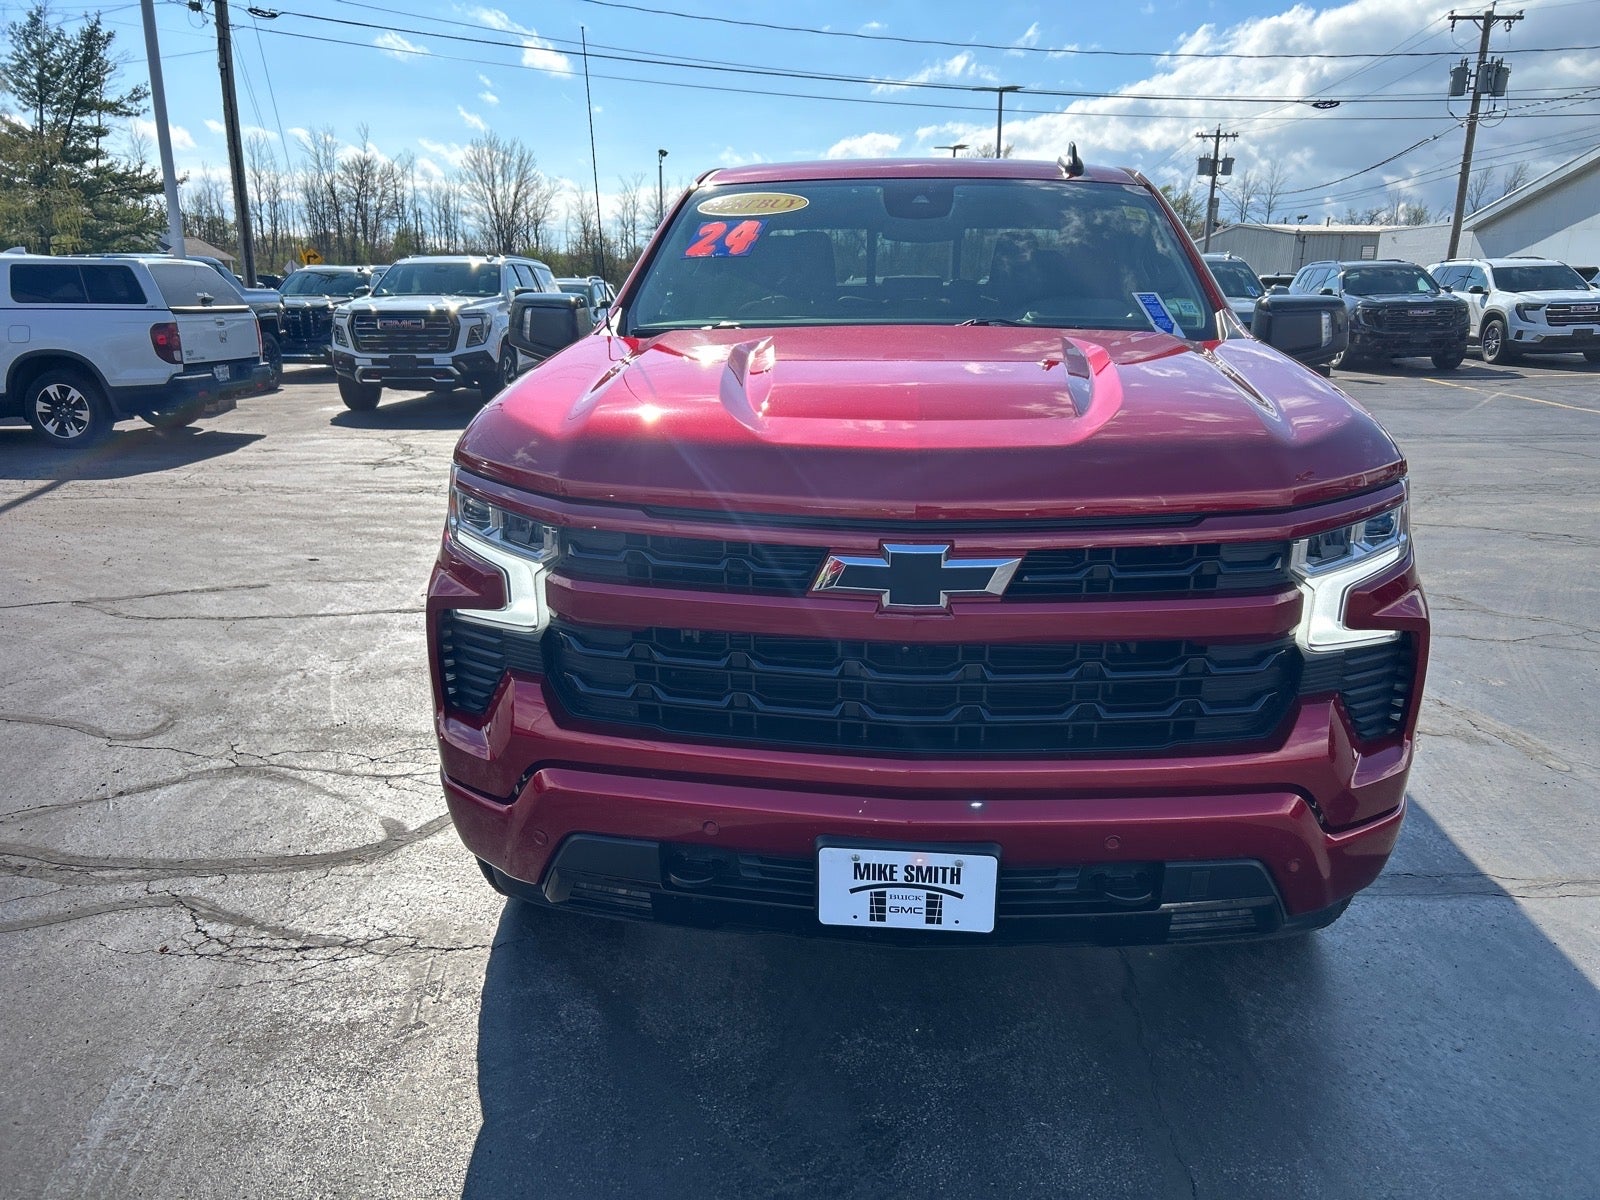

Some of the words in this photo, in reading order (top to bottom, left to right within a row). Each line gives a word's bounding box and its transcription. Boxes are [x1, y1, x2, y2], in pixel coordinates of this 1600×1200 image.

[754, 198, 804, 209] BUY
[685, 220, 761, 257] 24
[378, 319, 423, 329] GMC
[853, 862, 898, 882] MIKE
[904, 864, 962, 885] SMITH
[889, 893, 924, 901] BUICK
[888, 905, 924, 915] GMC
